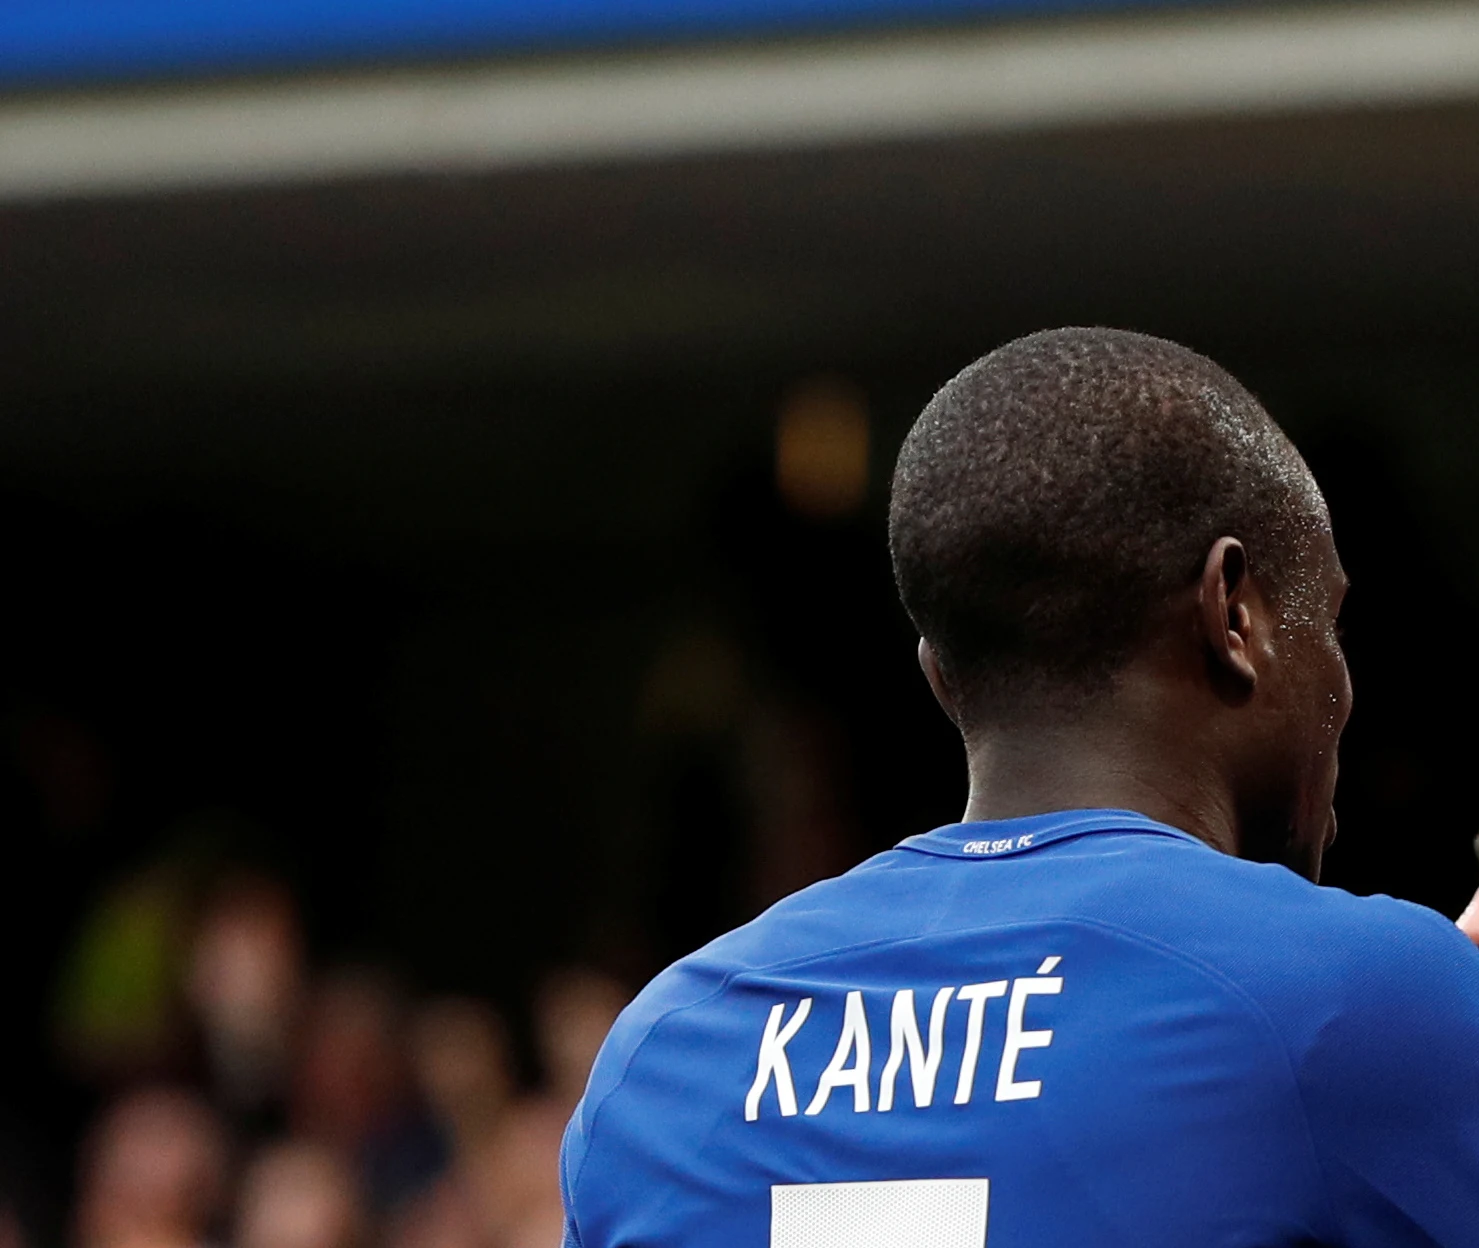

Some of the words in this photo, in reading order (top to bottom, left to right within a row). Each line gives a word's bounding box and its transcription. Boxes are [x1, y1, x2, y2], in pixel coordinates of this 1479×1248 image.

[963, 839, 1013, 854] CHELSEA
[1017, 833, 1034, 849] FC
[745, 956, 1064, 1122] KANTÉ
